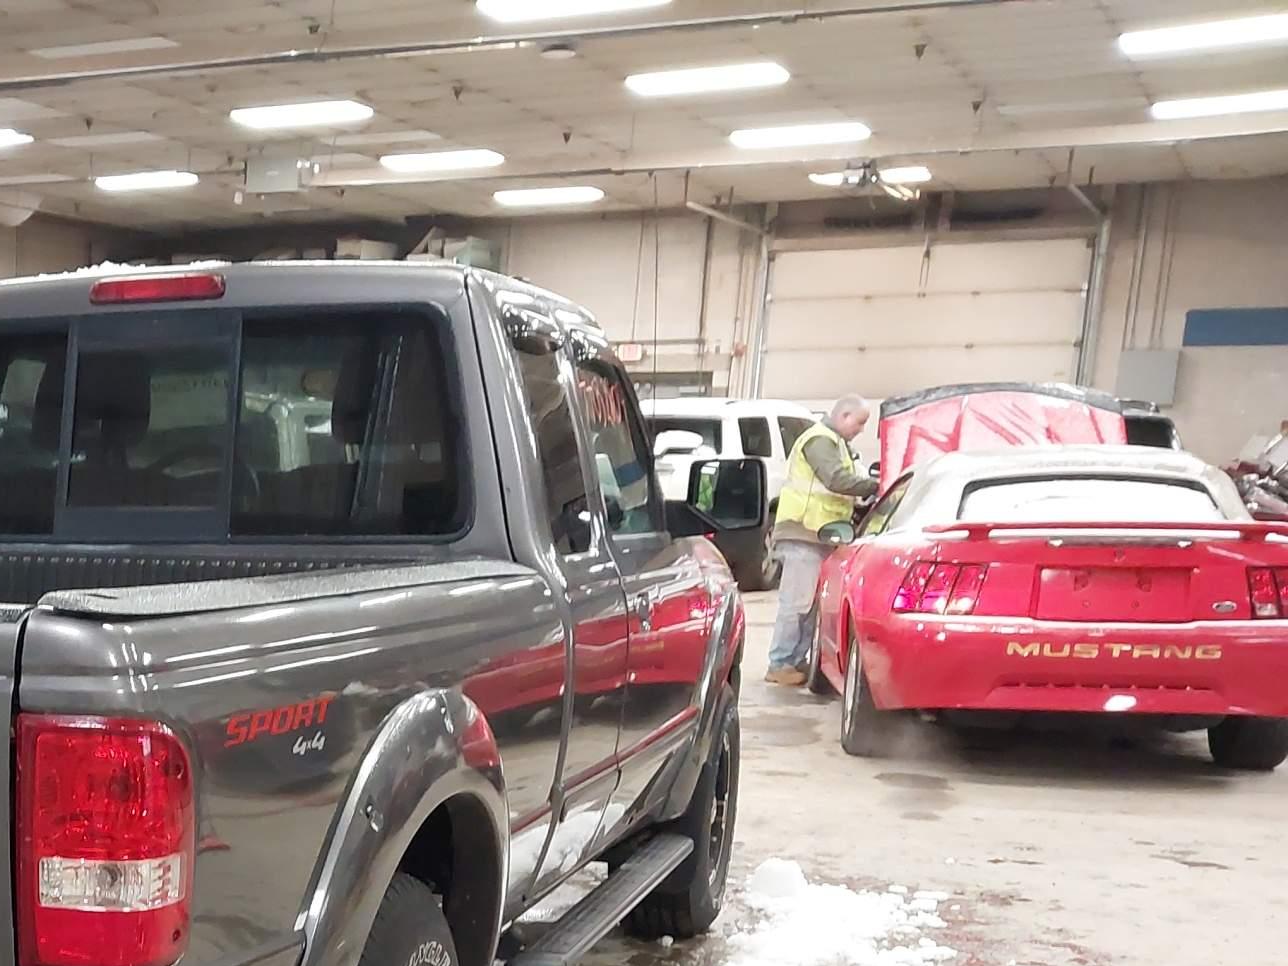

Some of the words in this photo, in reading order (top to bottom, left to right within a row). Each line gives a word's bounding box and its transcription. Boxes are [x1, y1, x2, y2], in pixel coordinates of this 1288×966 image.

[1007, 641, 1222, 659] MUSTANG
[224, 694, 336, 748] SPORT
[292, 731, 326, 755] 4x4
